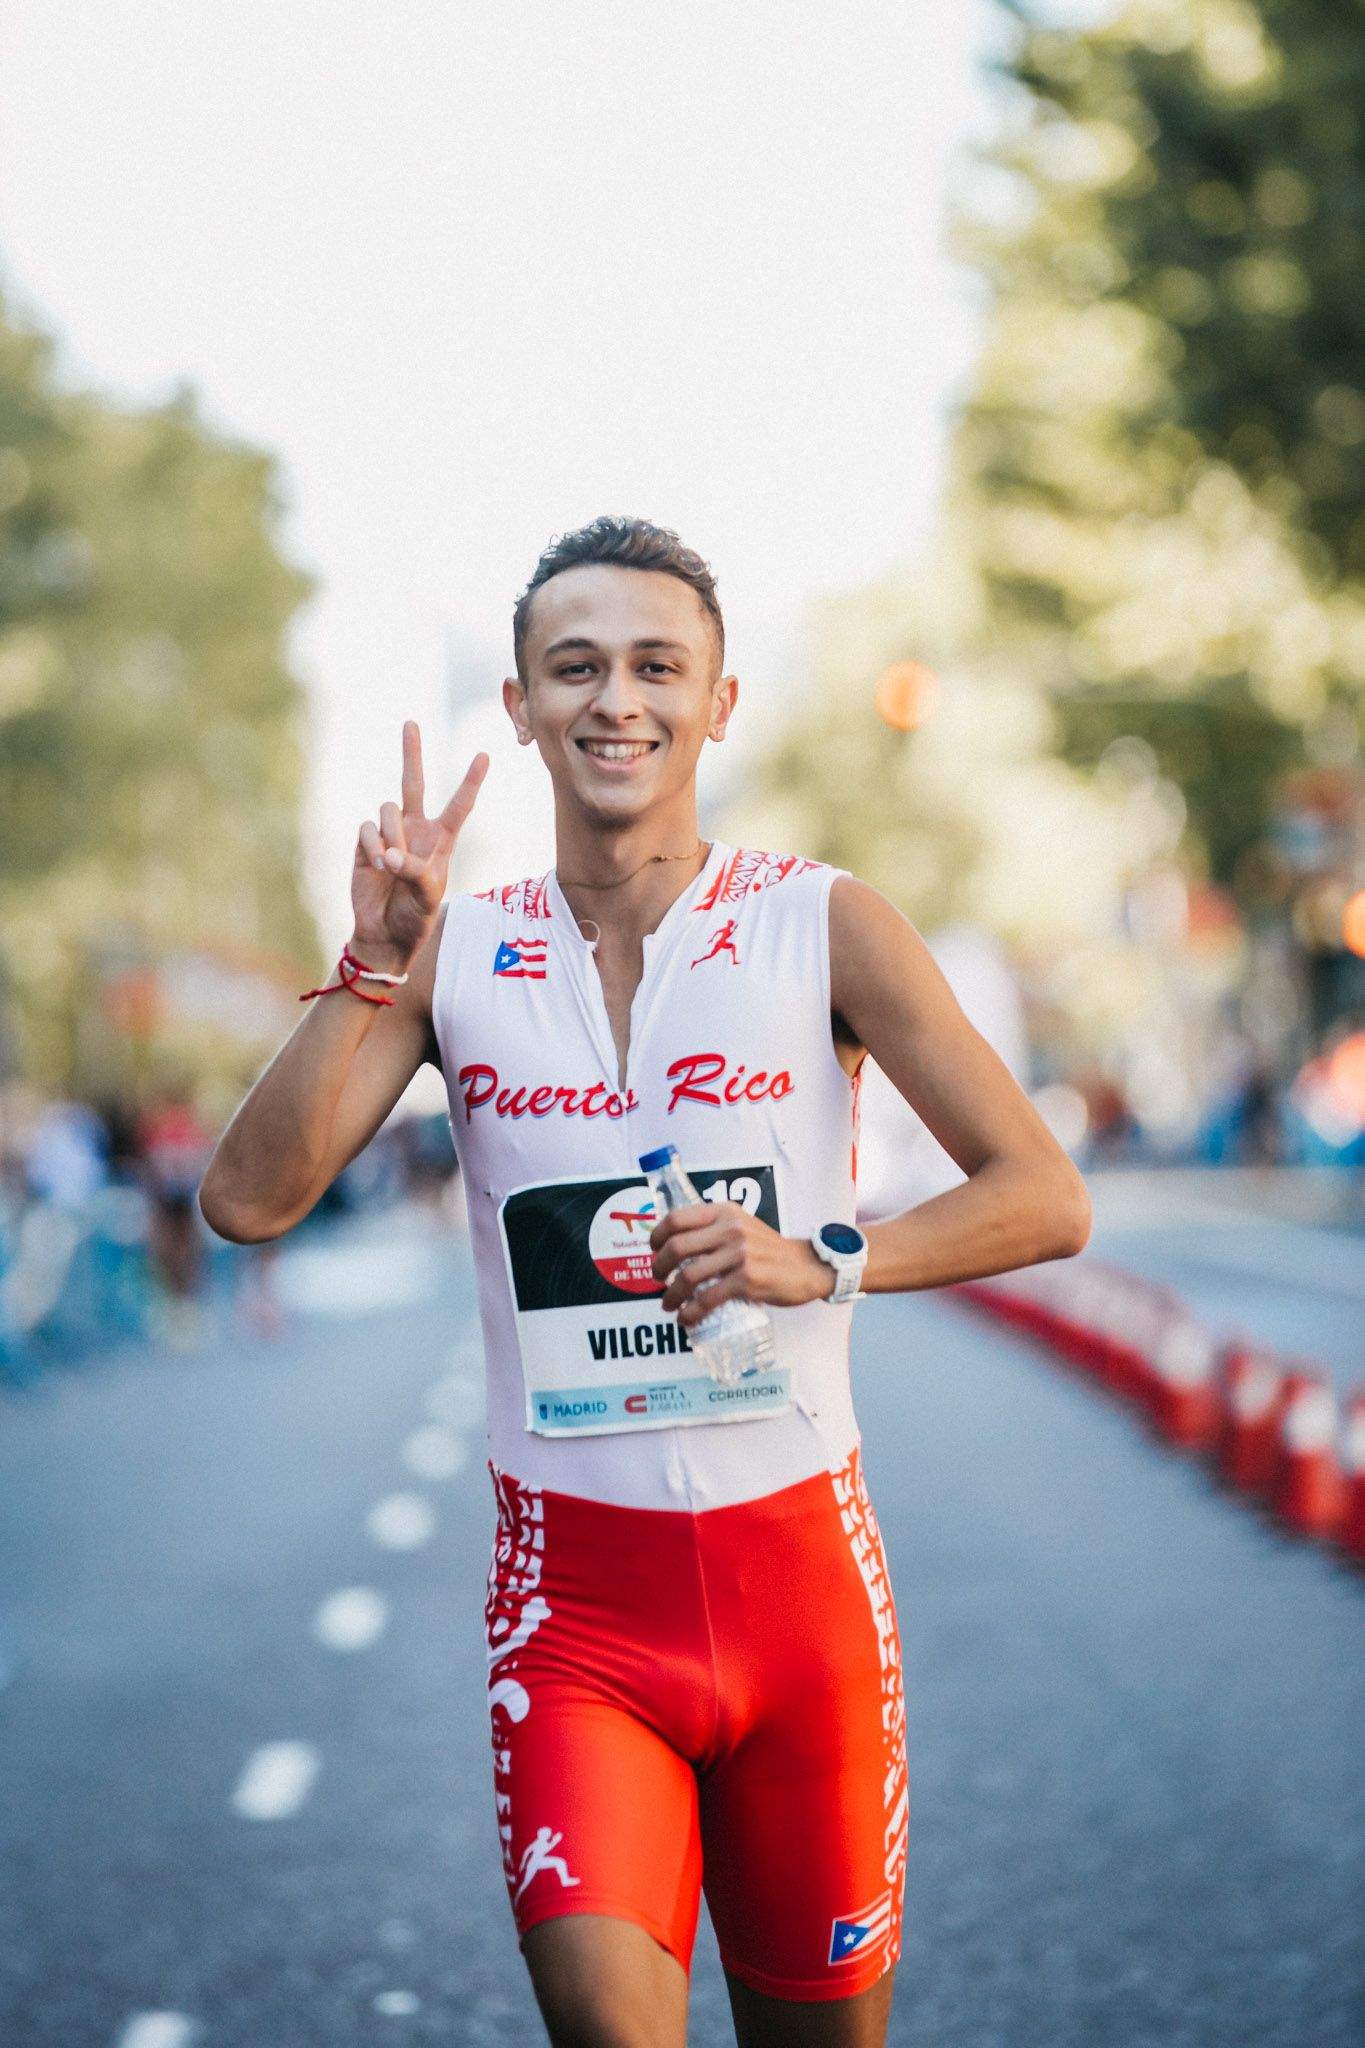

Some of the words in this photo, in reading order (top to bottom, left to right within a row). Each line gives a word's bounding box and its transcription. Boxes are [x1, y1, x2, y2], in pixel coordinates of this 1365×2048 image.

[458, 1063, 639, 1125] Puerto
[666, 1052, 795, 1115] Rico
[587, 1322, 693, 1361] VILCHE
[553, 1401, 608, 1418] MADRID
